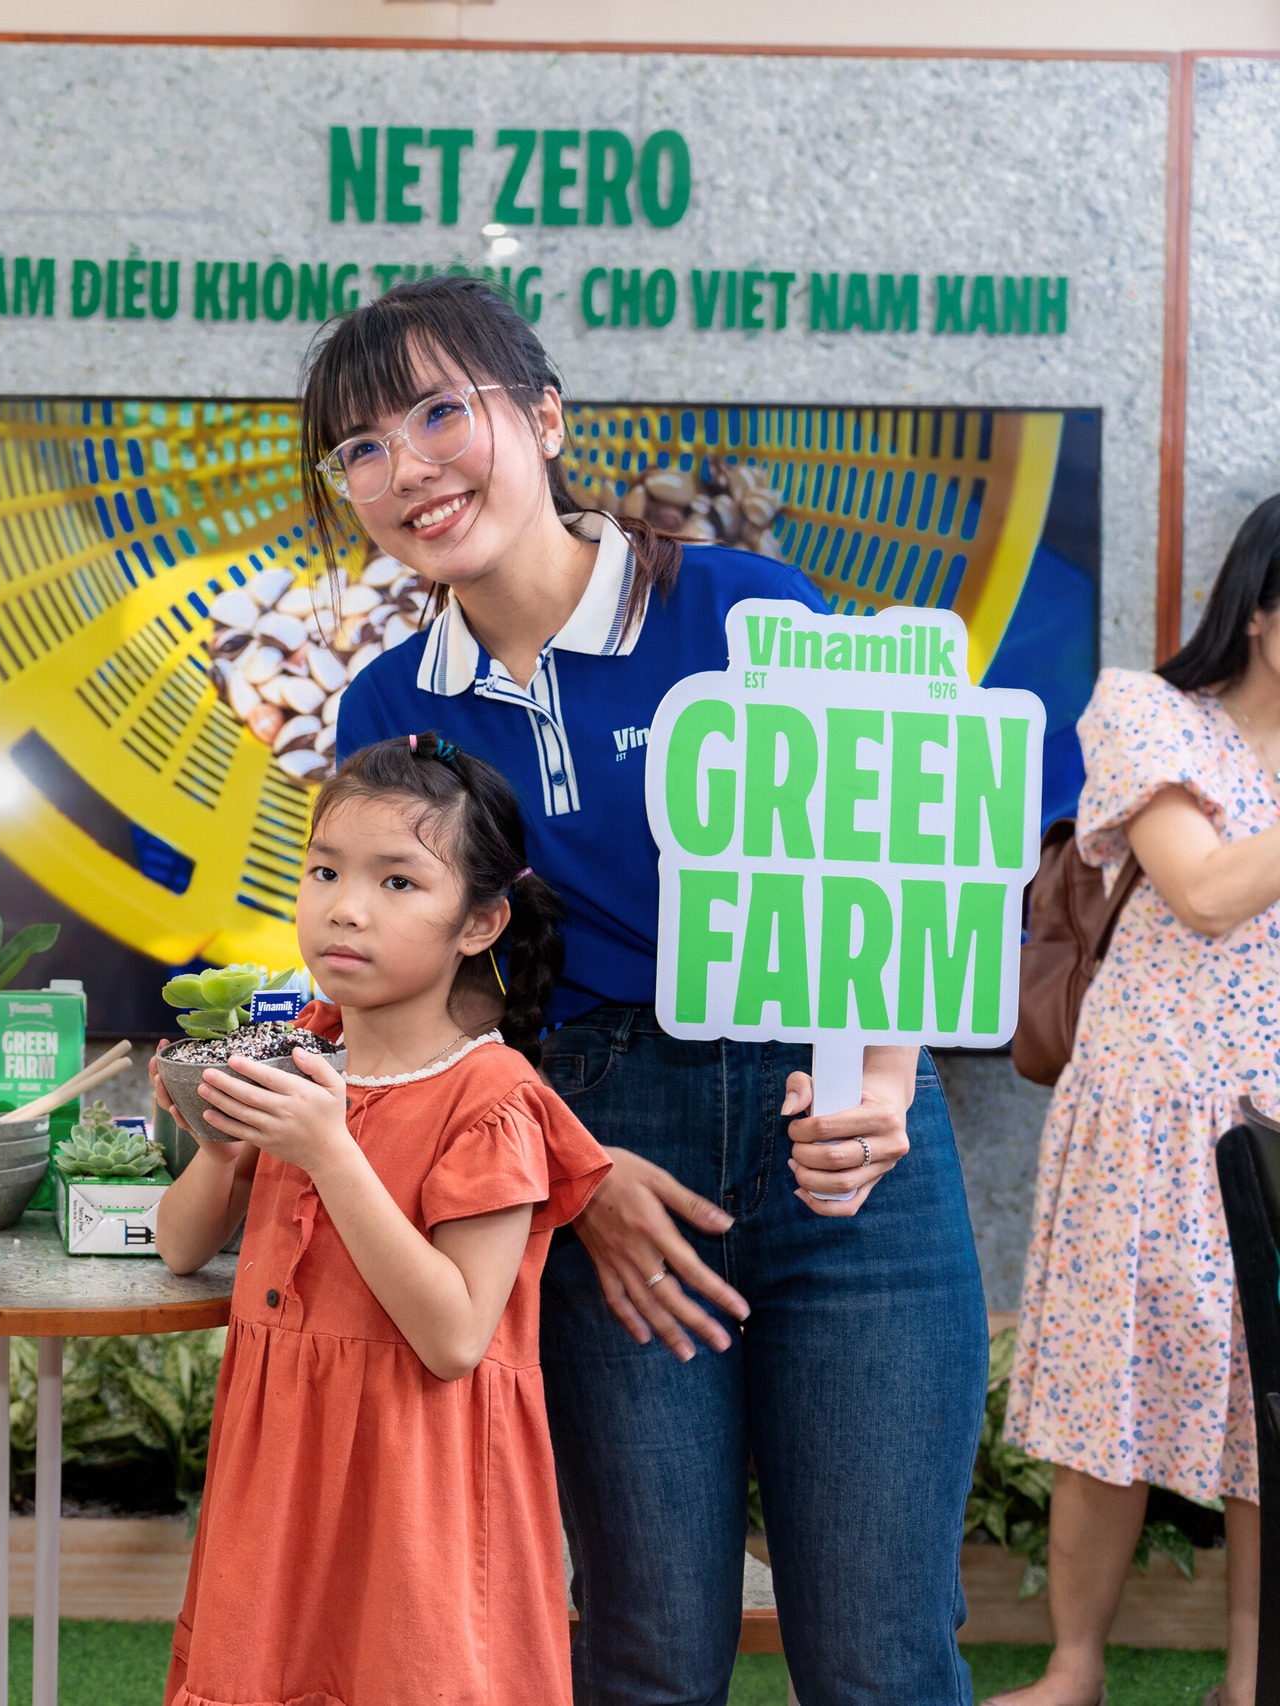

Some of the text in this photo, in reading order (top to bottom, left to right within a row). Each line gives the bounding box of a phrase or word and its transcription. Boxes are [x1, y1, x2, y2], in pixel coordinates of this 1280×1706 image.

[329, 125, 692, 228] NET ZERO
[581, 266, 677, 328] CHO
[809, 271, 920, 333] NAM
[932, 273, 1069, 334] XANH
[745, 615, 958, 678] Vinamilk
[744, 671, 957, 700] EST 1976
[616, 752, 626, 762] EST
[665, 698, 1030, 869] GREEN
[675, 869, 1007, 1035] FARM
[258, 1001, 293, 1011] Vinamilk
[2, 1030, 59, 1055] GREEN
[5, 1055, 56, 1079] FARM
